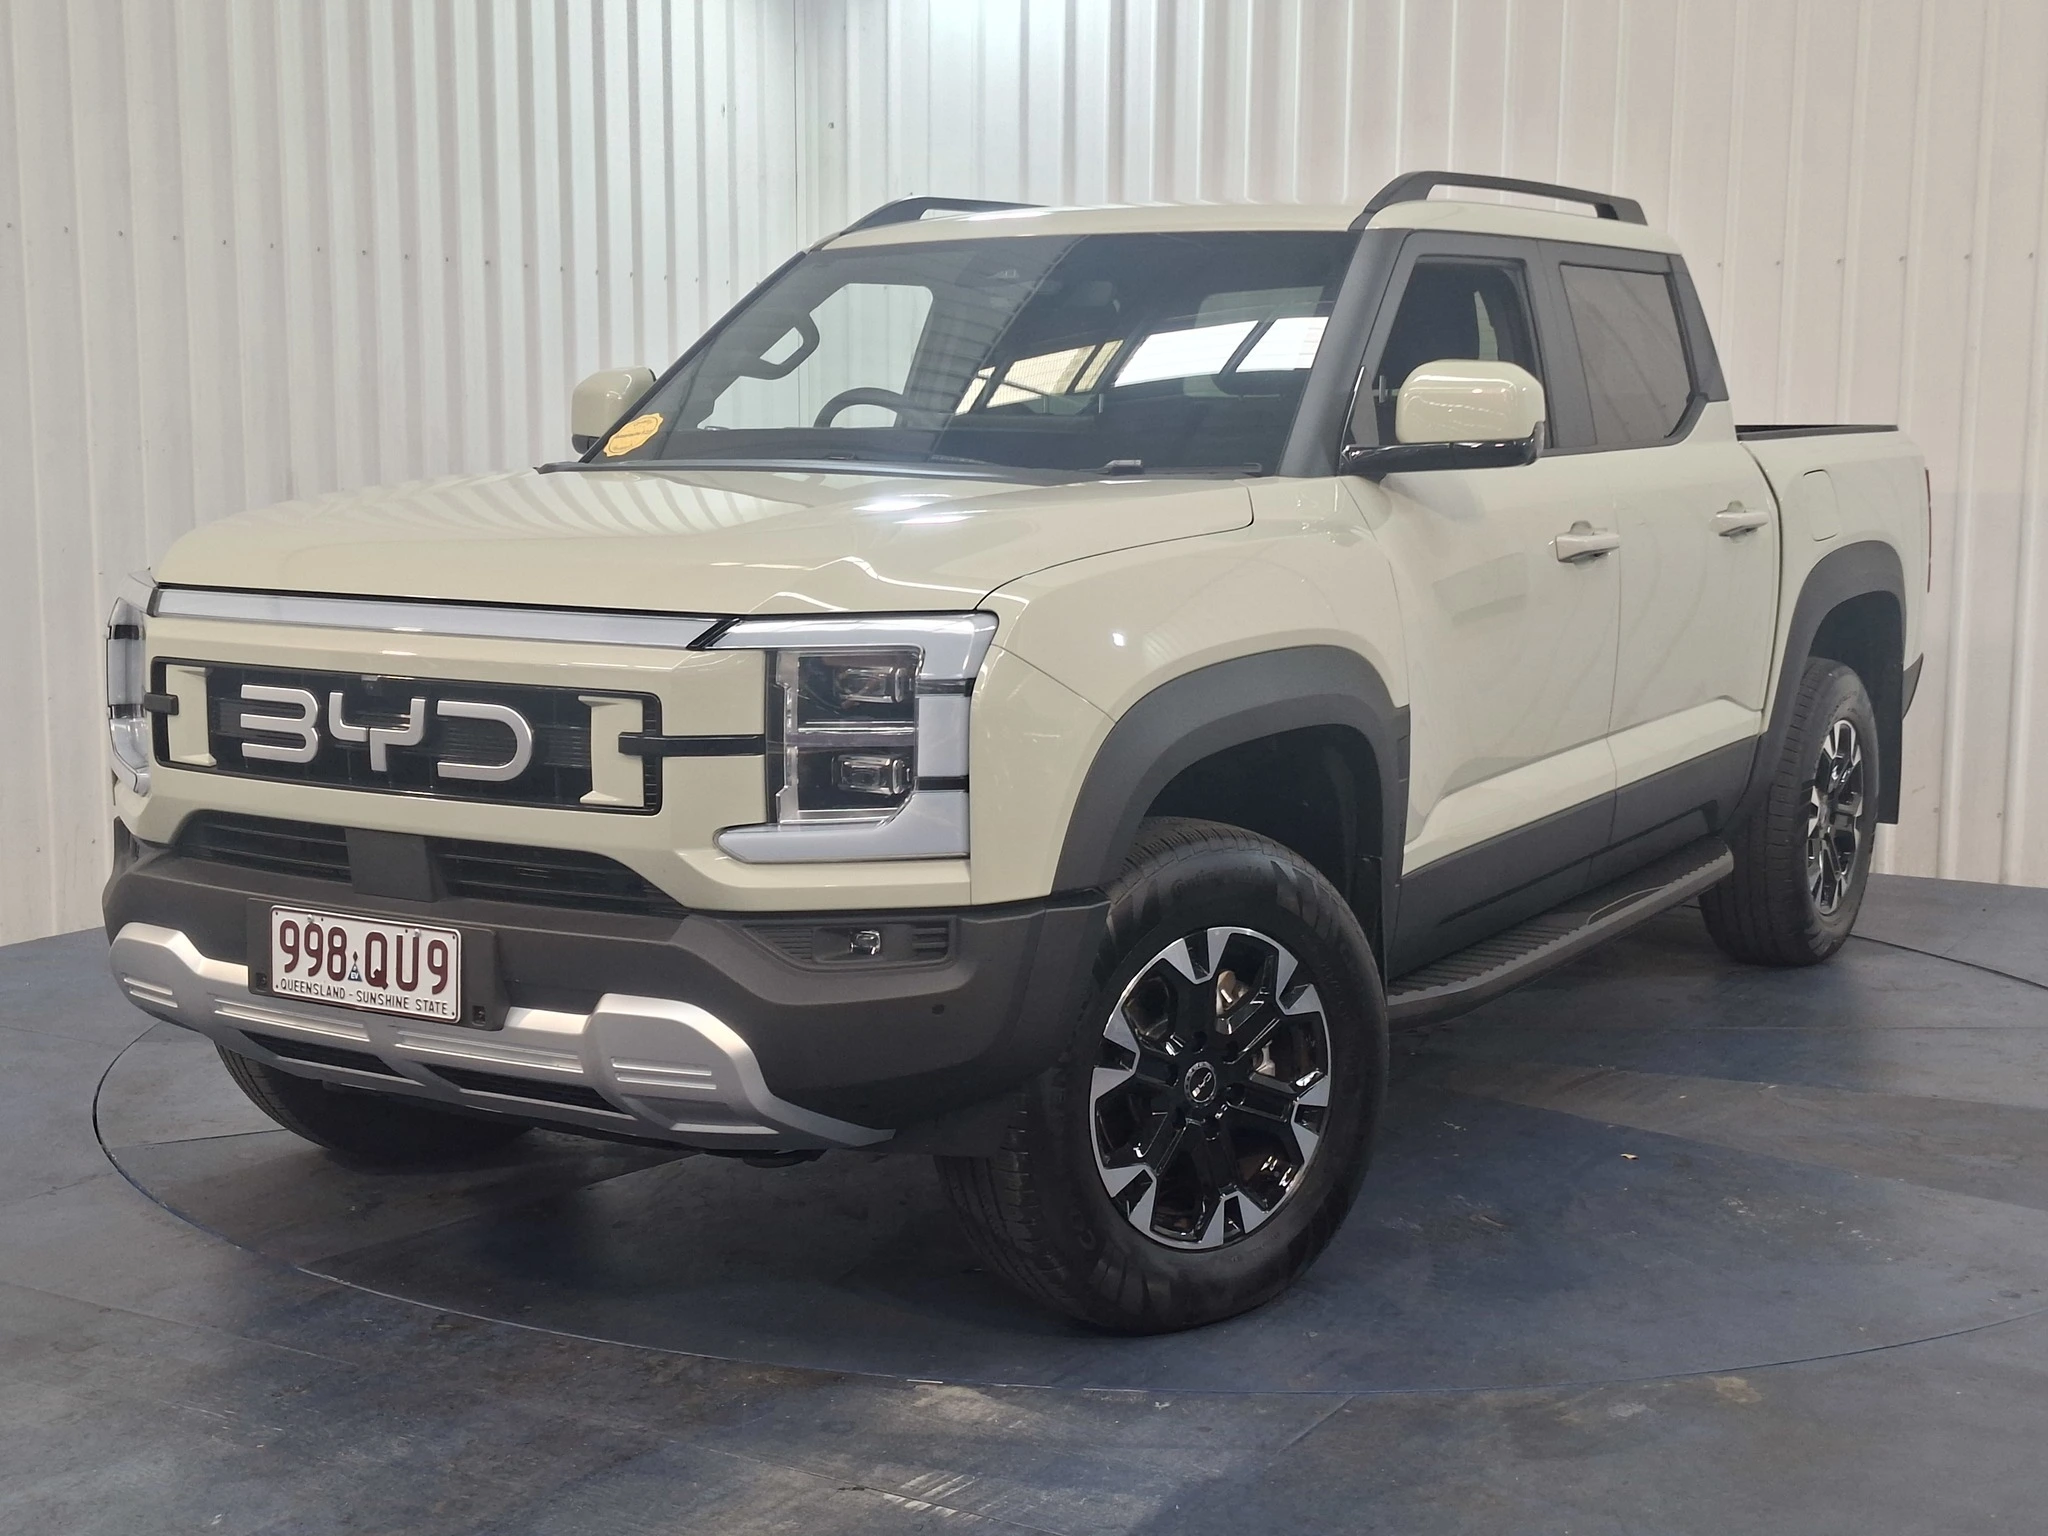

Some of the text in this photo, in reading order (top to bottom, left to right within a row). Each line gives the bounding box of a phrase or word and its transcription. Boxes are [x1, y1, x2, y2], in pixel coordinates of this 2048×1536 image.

[240, 684, 533, 782] BYD
[350, 971, 360, 980] EV
[280, 978, 346, 1000] QUEENSLAND
[356, 990, 410, 1009] SUNSHINE
[416, 999, 448, 1015] STATE
